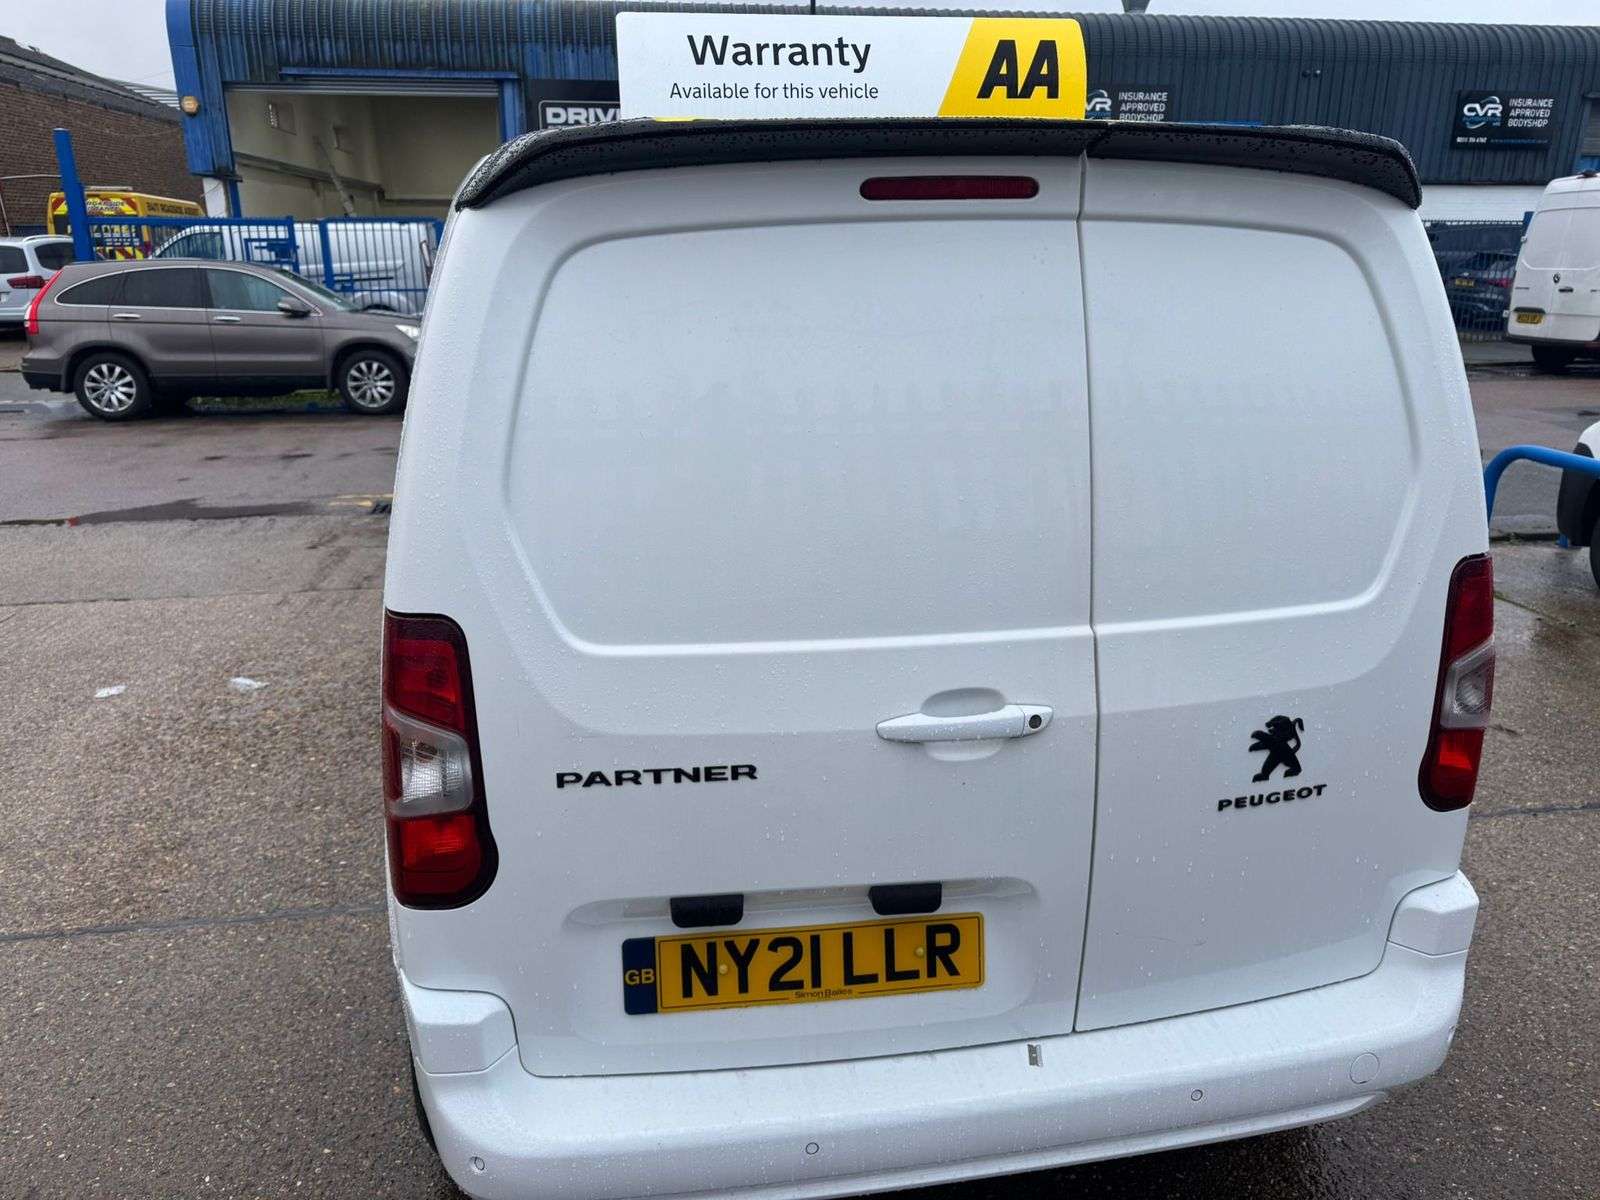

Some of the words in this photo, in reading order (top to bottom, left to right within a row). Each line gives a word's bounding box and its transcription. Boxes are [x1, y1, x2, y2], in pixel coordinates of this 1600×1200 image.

[687, 35, 871, 73] Warranty
[976, 39, 1059, 99] AA
[670, 83, 749, 99] Available
[754, 83, 778, 99] for
[783, 84, 814, 99] this
[818, 83, 879, 99] vehicle
[1118, 92, 1168, 101] INSURANCE
[1120, 103, 1166, 112] APPROVED
[1463, 103, 1503, 116] CVR
[1508, 98, 1554, 108] INSURANCE
[545, 107, 620, 124] DRIV
[1509, 109, 1551, 118] APPROVED
[1507, 119, 1549, 128] BODYSHOP
[556, 764, 758, 788] PARTNER
[1217, 783, 1328, 812] PEUGEOT
[680, 934, 822, 999] NY21
[842, 923, 962, 987] LLR
[624, 969, 655, 986] GB
